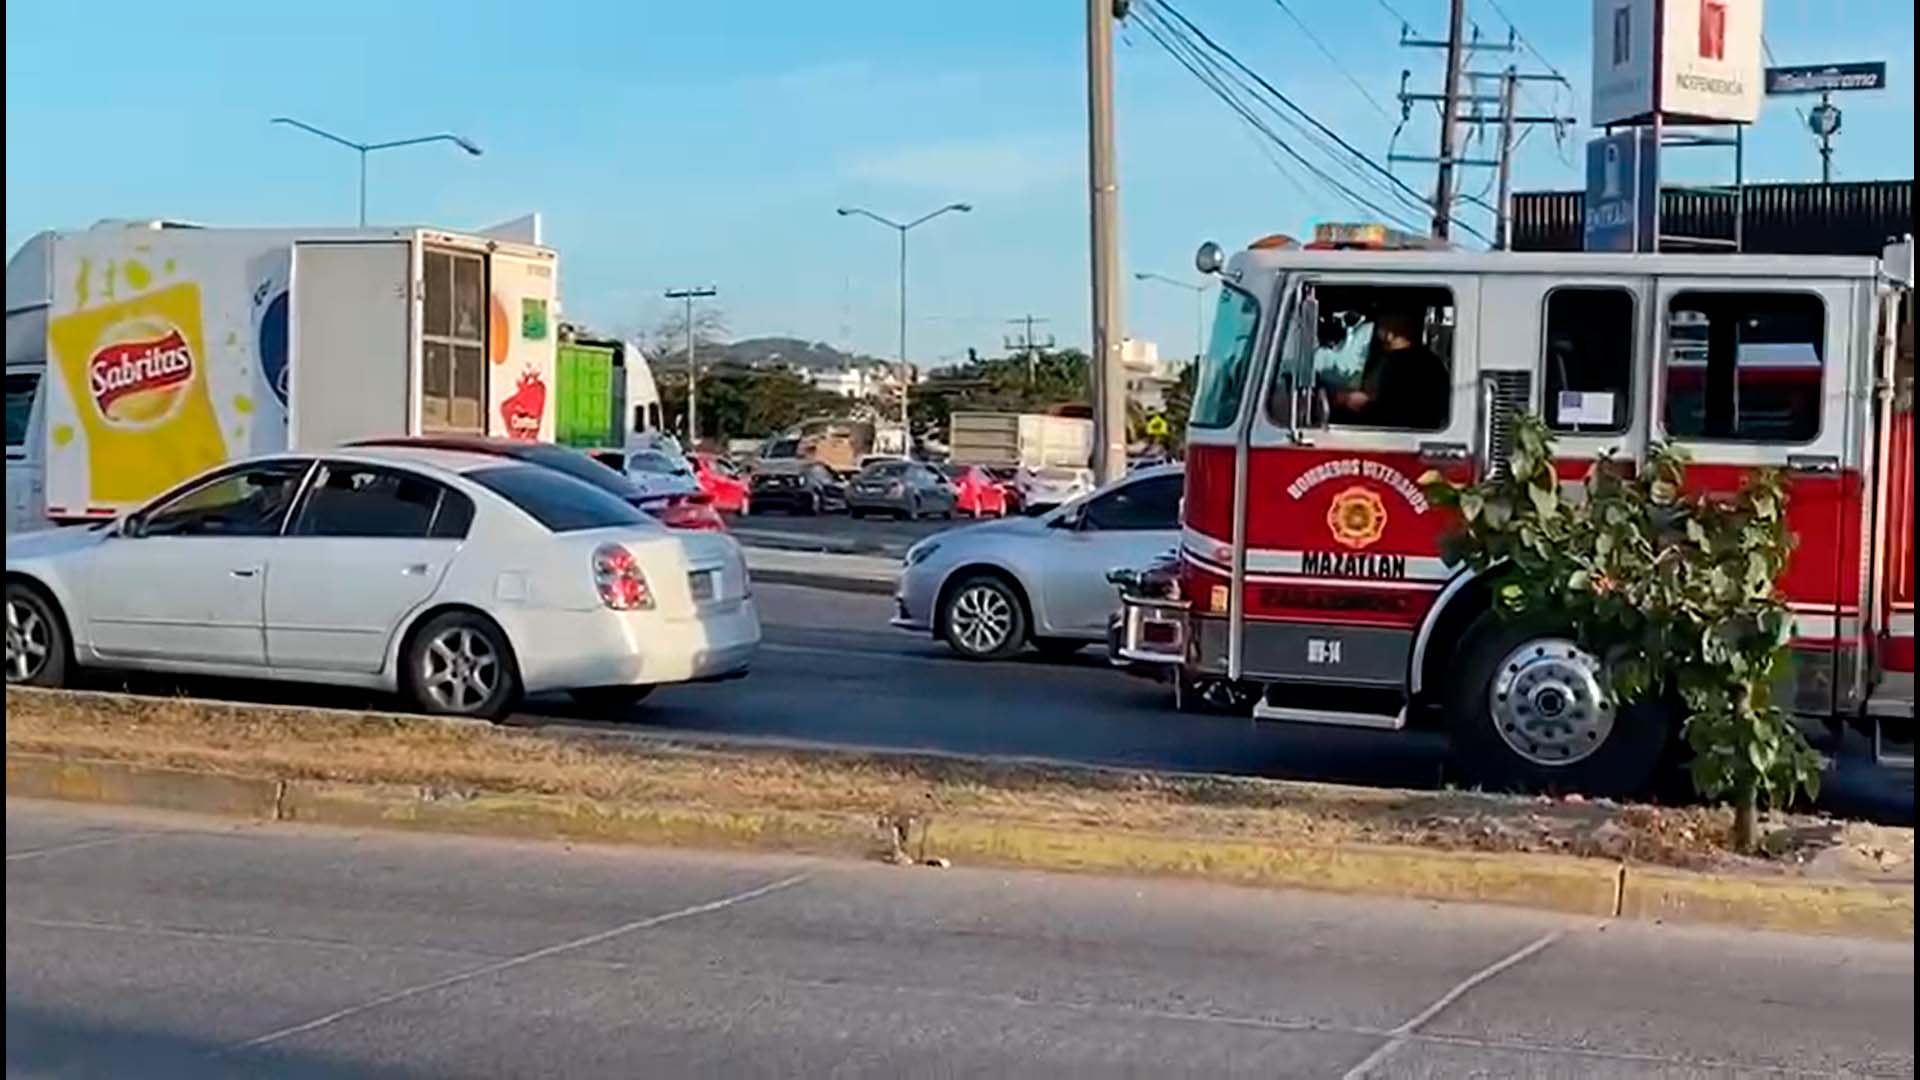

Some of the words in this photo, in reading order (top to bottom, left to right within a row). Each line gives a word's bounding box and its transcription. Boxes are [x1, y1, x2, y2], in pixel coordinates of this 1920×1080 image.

[90, 346, 189, 397] Sabritas
[1286, 458, 1361, 500] BOMBEROS
[1362, 459, 1430, 515] VETERANOS
